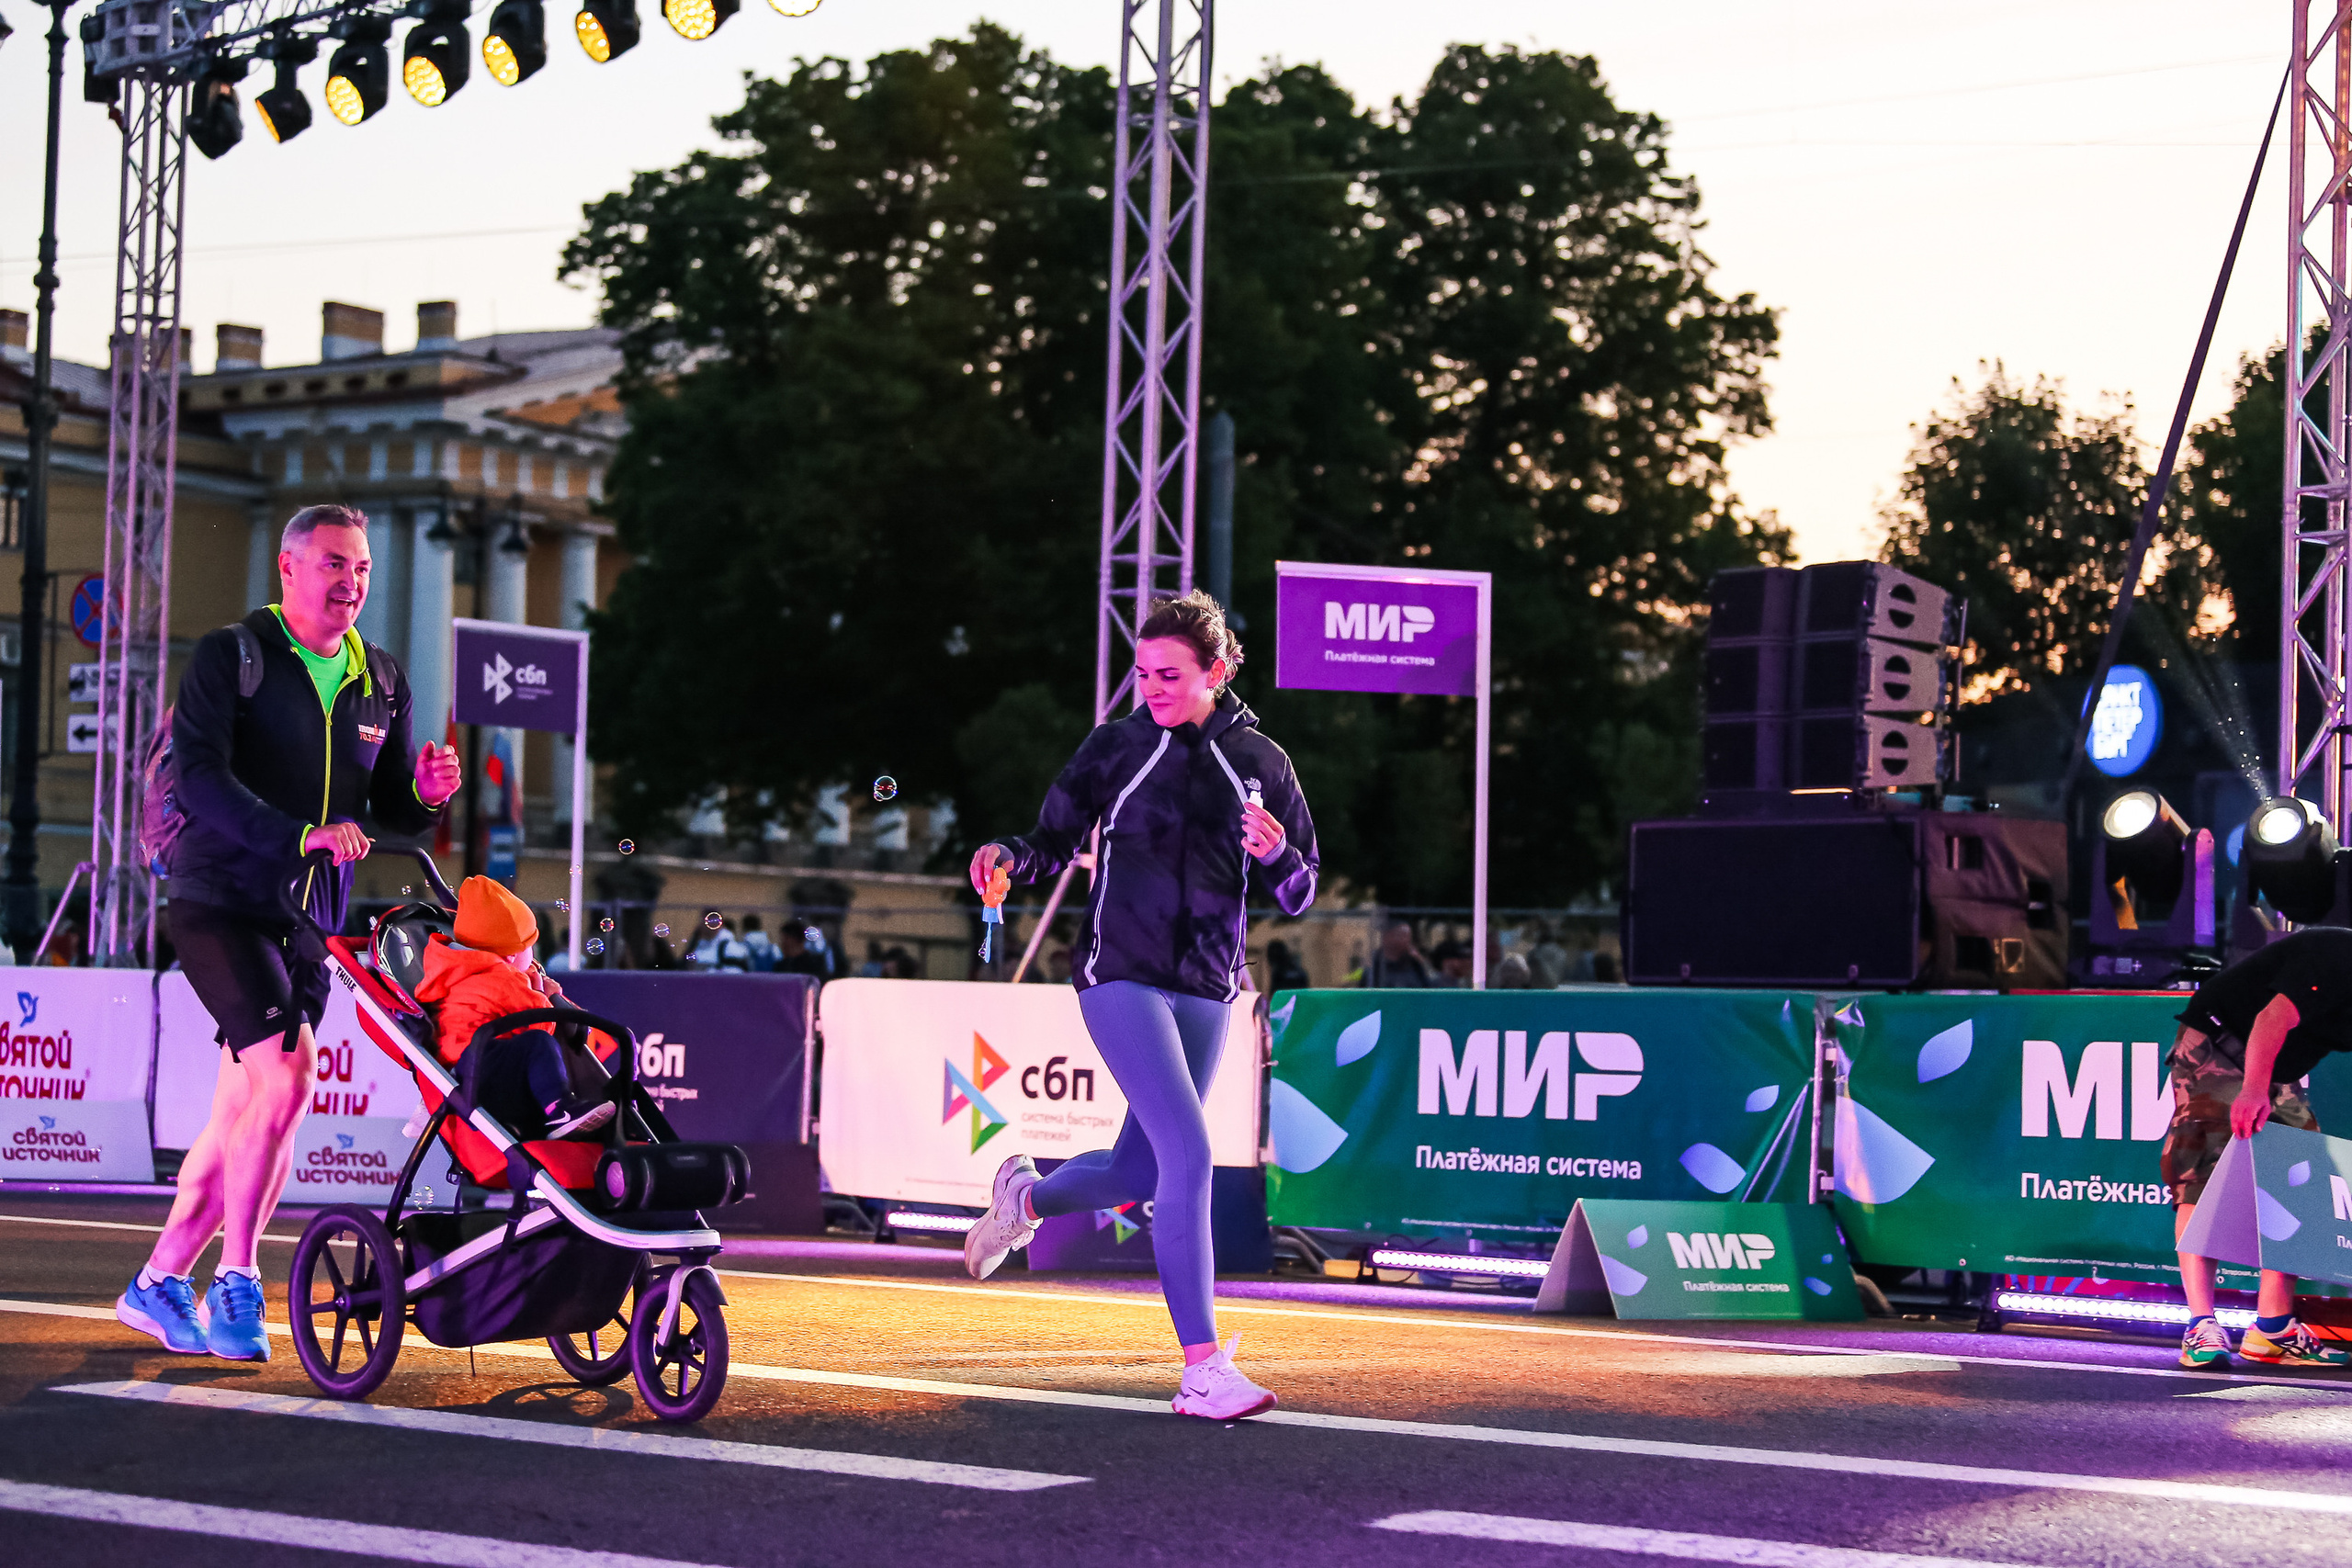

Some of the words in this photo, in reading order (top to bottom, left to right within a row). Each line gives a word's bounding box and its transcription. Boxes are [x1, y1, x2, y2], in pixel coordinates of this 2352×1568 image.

[1325, 601, 1435, 642] МИР
[1324, 649, 1387, 663] Платёжная
[1389, 653, 1436, 666] система
[334, 965, 357, 993] THULE
[634, 1032, 686, 1078] бп
[1417, 1027, 1645, 1122] МИР
[1022, 1111, 1065, 1124] система
[1067, 1111, 1114, 1129] быстрых
[1416, 1145, 1540, 1174] Платёжная
[1545, 1156, 1643, 1180] система
[1666, 1232, 1776, 1269] МИР
[1746, 1283, 1791, 1293] система
